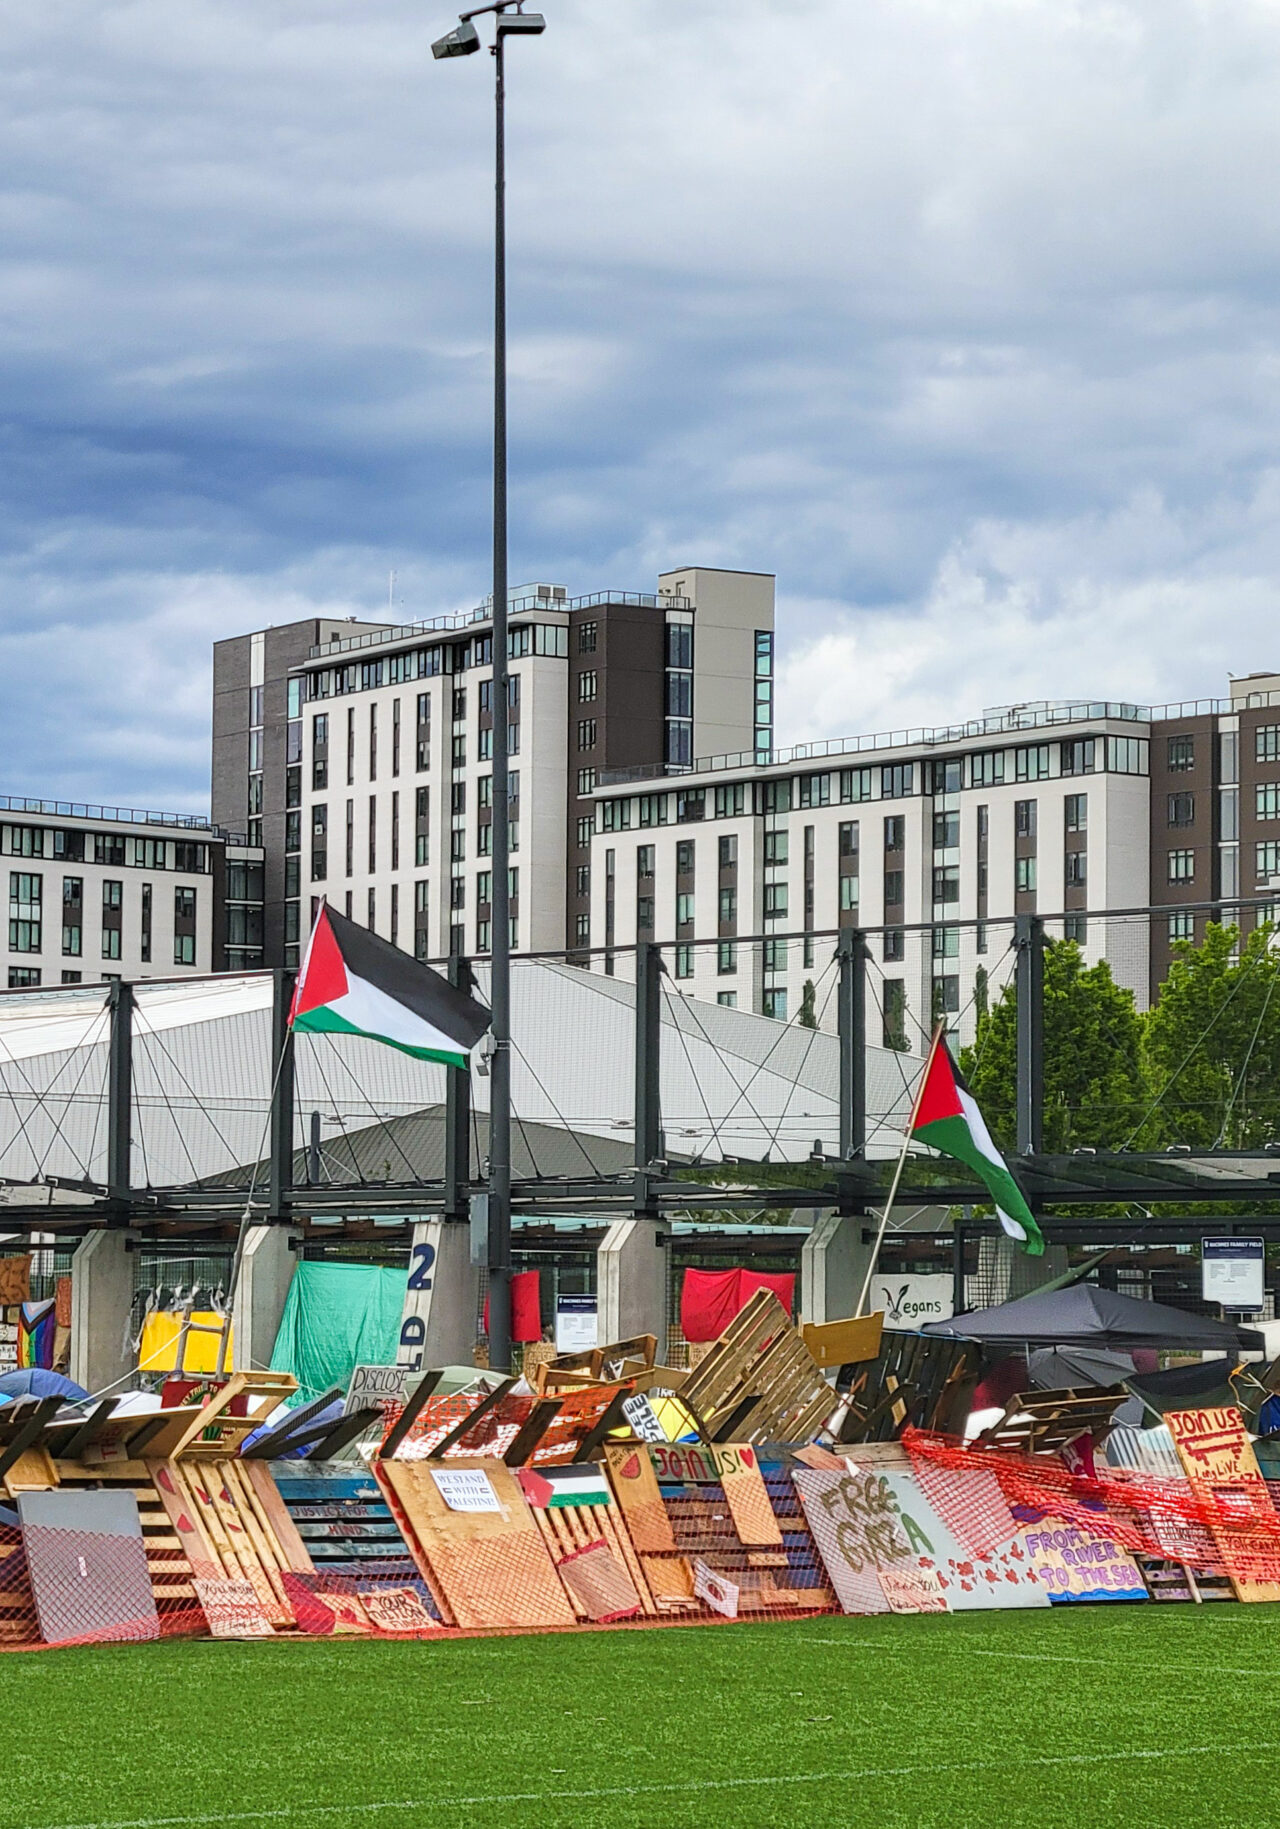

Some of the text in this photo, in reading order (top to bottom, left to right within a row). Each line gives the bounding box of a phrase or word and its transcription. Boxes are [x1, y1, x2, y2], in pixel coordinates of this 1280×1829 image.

[407, 1243, 435, 1290] 2
[882, 1284, 942, 1320] Vegans
[353, 1367, 407, 1394] DISCLOSE
[447, 1497, 496, 1506] PALESTINE!
[453, 1487, 479, 1495] WITH
[820, 1476, 900, 1519] FREE
[293, 1506, 369, 1517] JUSTICE FOR
[1025, 1528, 1083, 1558] FROM
[1061, 1541, 1119, 1566] RIVER
[1039, 1567, 1070, 1589] TO
[1074, 1565, 1113, 1587] THE
[1110, 1564, 1145, 1587] SEA
[373, 1594, 413, 1611] YOUR
